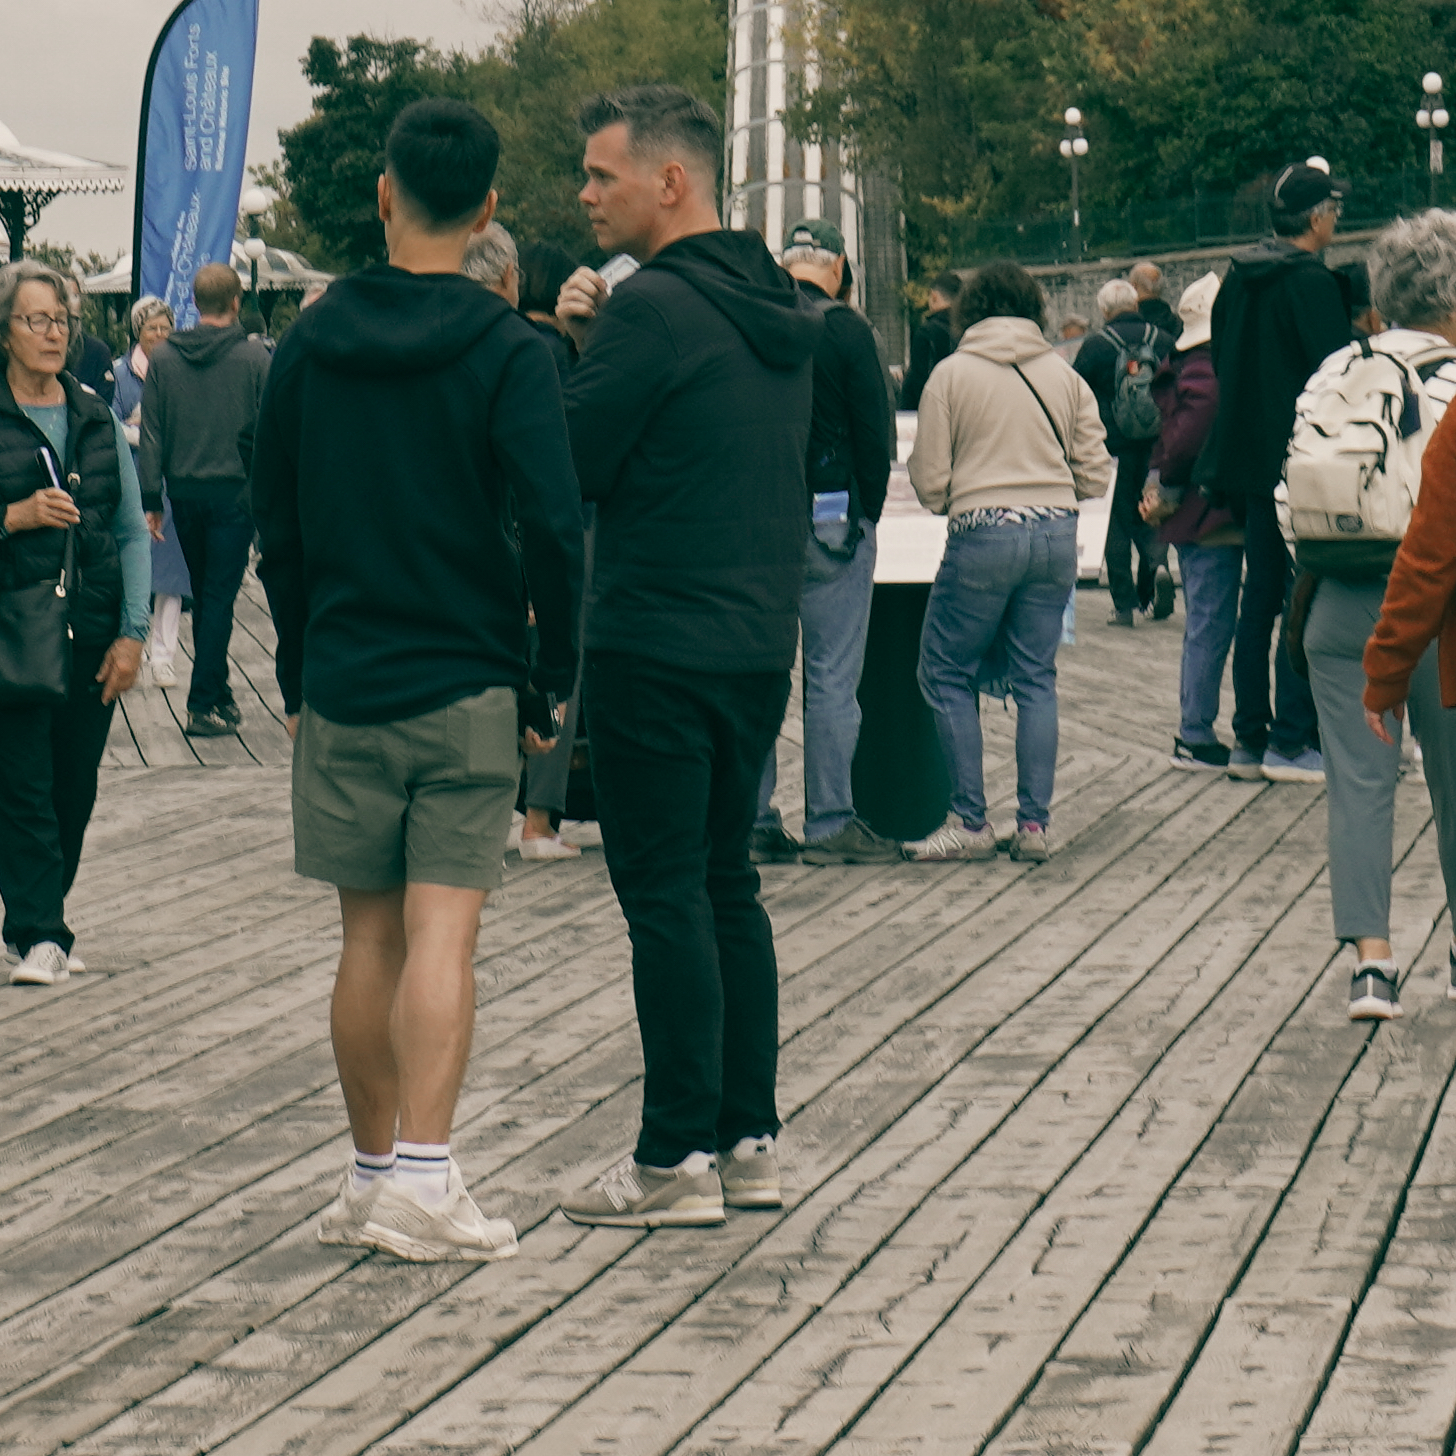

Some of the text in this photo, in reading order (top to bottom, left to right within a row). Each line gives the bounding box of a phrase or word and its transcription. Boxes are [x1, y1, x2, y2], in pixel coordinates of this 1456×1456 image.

[183, 22, 200, 171] Saint-Louis Forts
[199, 136, 213, 171] and
